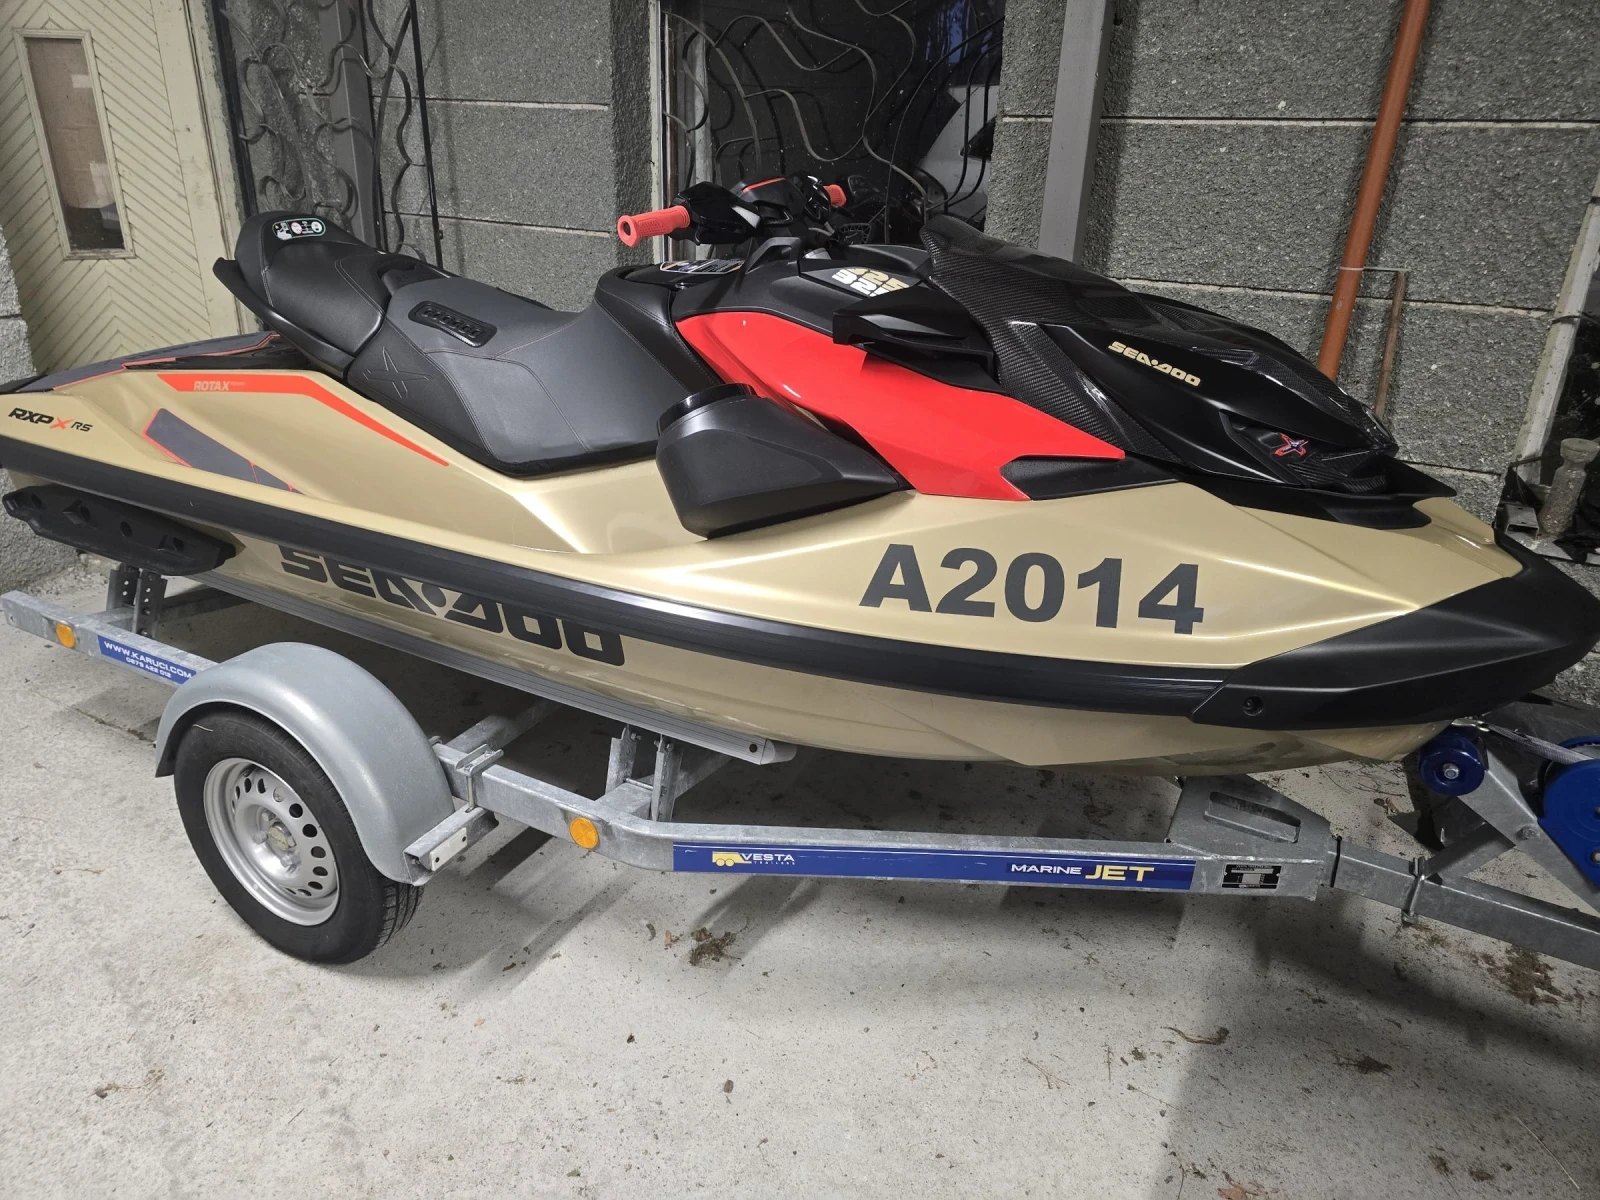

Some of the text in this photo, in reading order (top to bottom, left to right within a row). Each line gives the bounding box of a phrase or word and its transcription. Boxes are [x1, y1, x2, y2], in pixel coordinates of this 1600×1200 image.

[194, 381, 230, 391] ROTAX
[71, 421, 93, 432] RS
[859, 543, 1205, 635] A2014
[103, 640, 192, 679] WWW.KARUCI.COM
[740, 852, 795, 862] VESTA
[1011, 864, 1155, 882] MARINE JET
